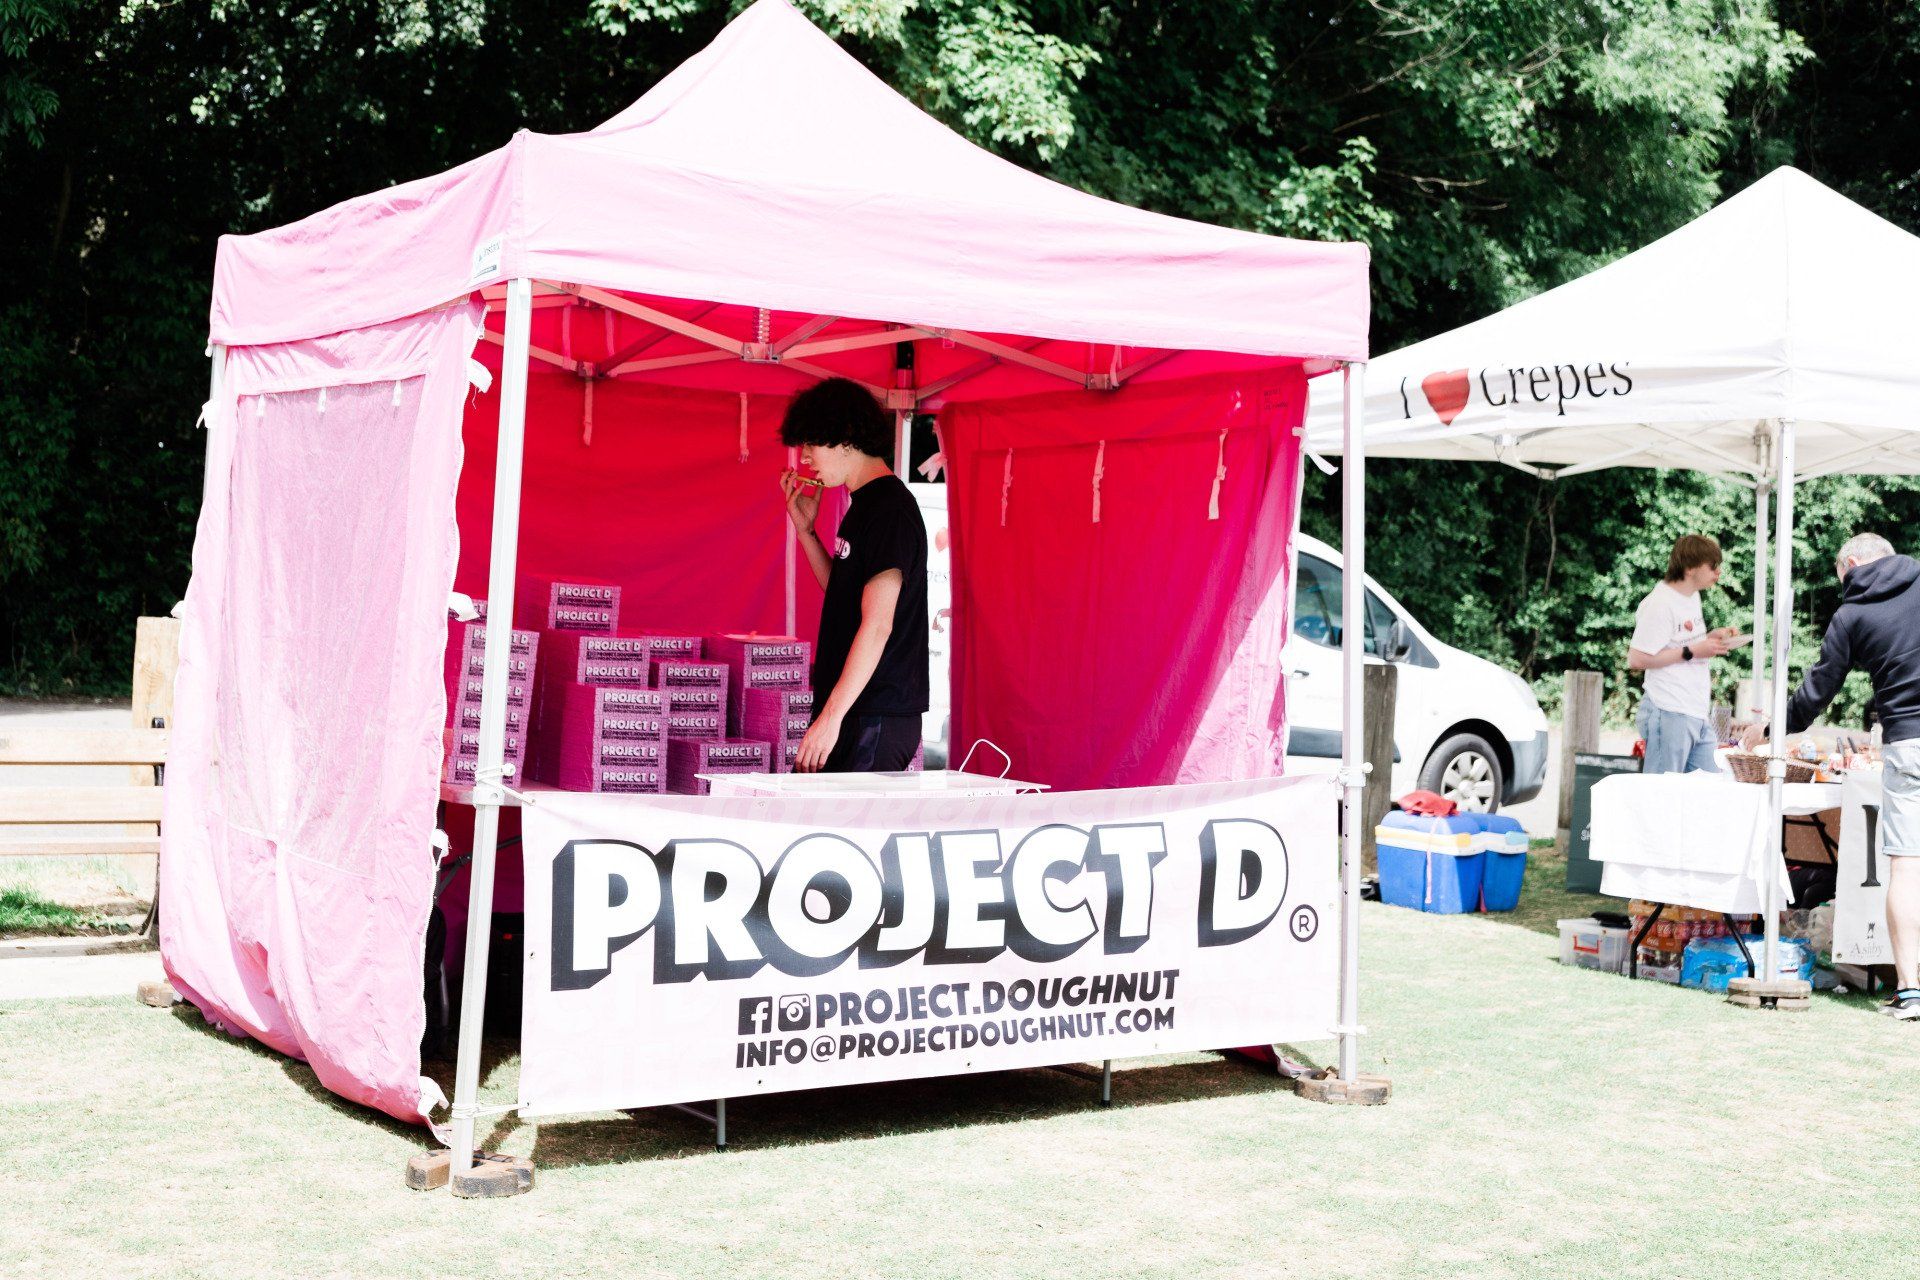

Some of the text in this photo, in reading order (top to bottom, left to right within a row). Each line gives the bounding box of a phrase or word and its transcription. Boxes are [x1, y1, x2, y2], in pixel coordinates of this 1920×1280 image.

[1480, 361, 1633, 416] Crepes
[559, 587, 611, 599] PROJECT D
[556, 611, 609, 622] PROJECT D
[519, 634, 528, 646] D
[650, 640, 692, 649] OJECT D
[587, 640, 641, 652] PROJECT D
[752, 646, 802, 656] PROJECT D
[517, 660, 526, 671] D
[585, 666, 639, 677] PROJECT D
[667, 667, 720, 677] PROJECT D
[751, 670, 801, 681] PROJECT D
[514, 686, 522, 696] D
[604, 692, 660, 704] PROJECT D
[671, 692, 718, 702] ROJECT D
[789, 694, 814, 704] PROJ
[510, 712, 518, 722] D
[710, 718, 717, 727] D
[603, 719, 658, 731] PROJECT D
[508, 738, 517, 748] D
[601, 745, 657, 757] PROJECT D
[708, 747, 761, 757] PROJECT D
[602, 771, 657, 782] PROJECT D
[551, 822, 1168, 991] PROJECT
[1198, 818, 1289, 947] D
[816, 969, 1180, 1029] PROJECT.DOUGHNUT
[736, 1006, 1175, 1069] INFO@PROJECTDOUGHNUT.COM
